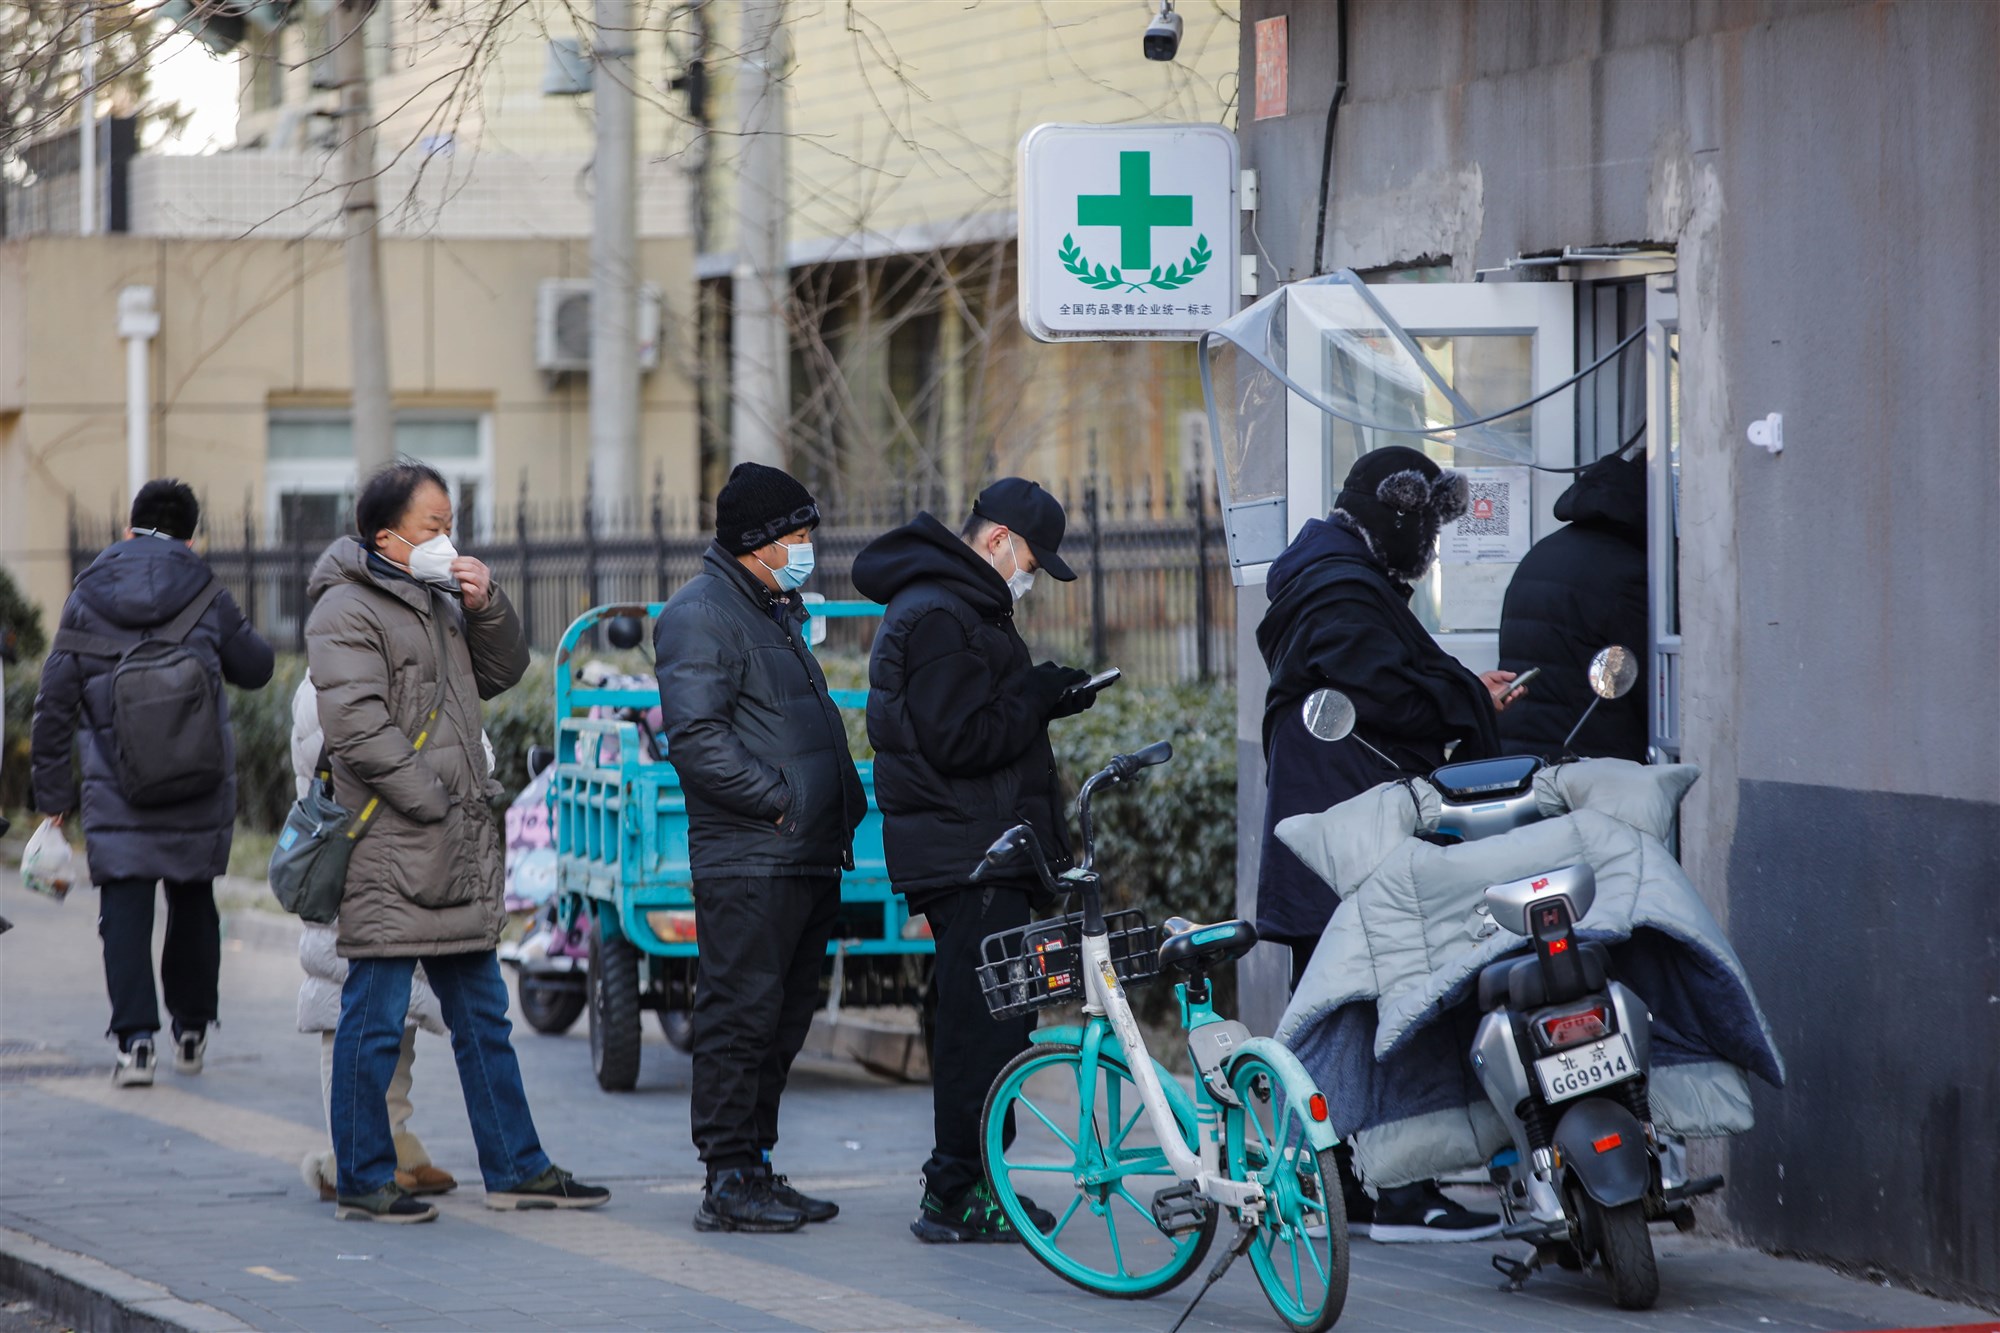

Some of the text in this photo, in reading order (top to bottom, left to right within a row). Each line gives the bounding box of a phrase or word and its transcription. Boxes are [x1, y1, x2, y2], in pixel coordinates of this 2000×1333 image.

[1059, 303, 1212, 315] 全国药品零售企业统一标志
[741, 503, 820, 546] SPO
[1560, 1048, 1607, 1071] 北京
[1552, 1056, 1628, 1095] GG9914
